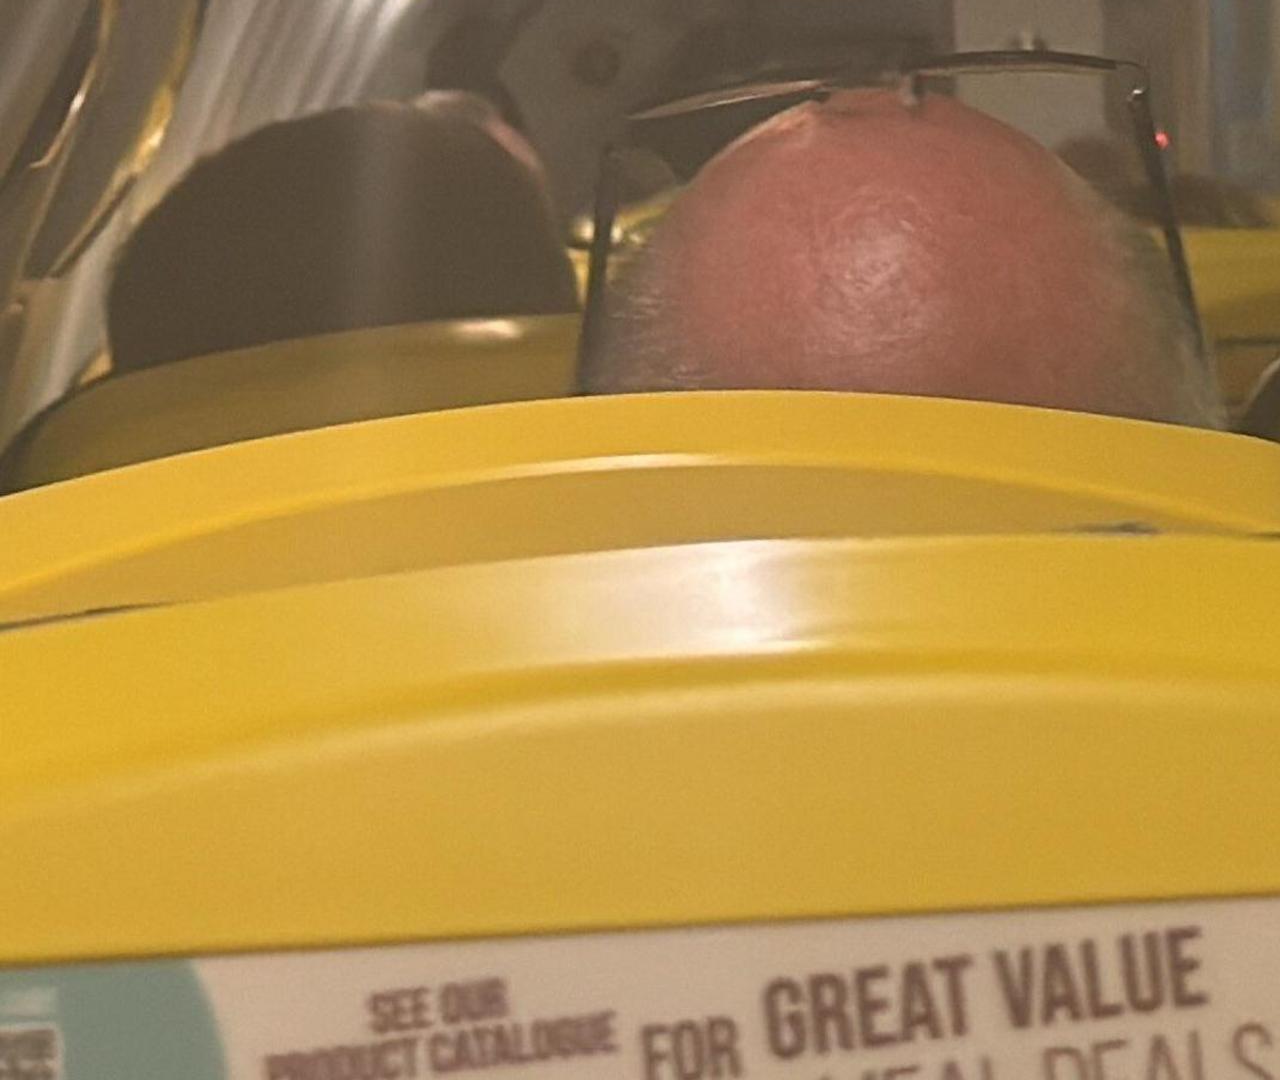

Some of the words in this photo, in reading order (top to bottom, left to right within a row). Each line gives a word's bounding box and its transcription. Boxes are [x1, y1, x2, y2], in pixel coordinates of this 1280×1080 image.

[368, 987, 432, 1035] SEE
[438, 975, 508, 1024] OUR
[760, 953, 973, 1062] GREAT
[992, 925, 1210, 1030] VALUE
[427, 1008, 621, 1074] CATALOGUE
[640, 1014, 746, 1080] FOR
